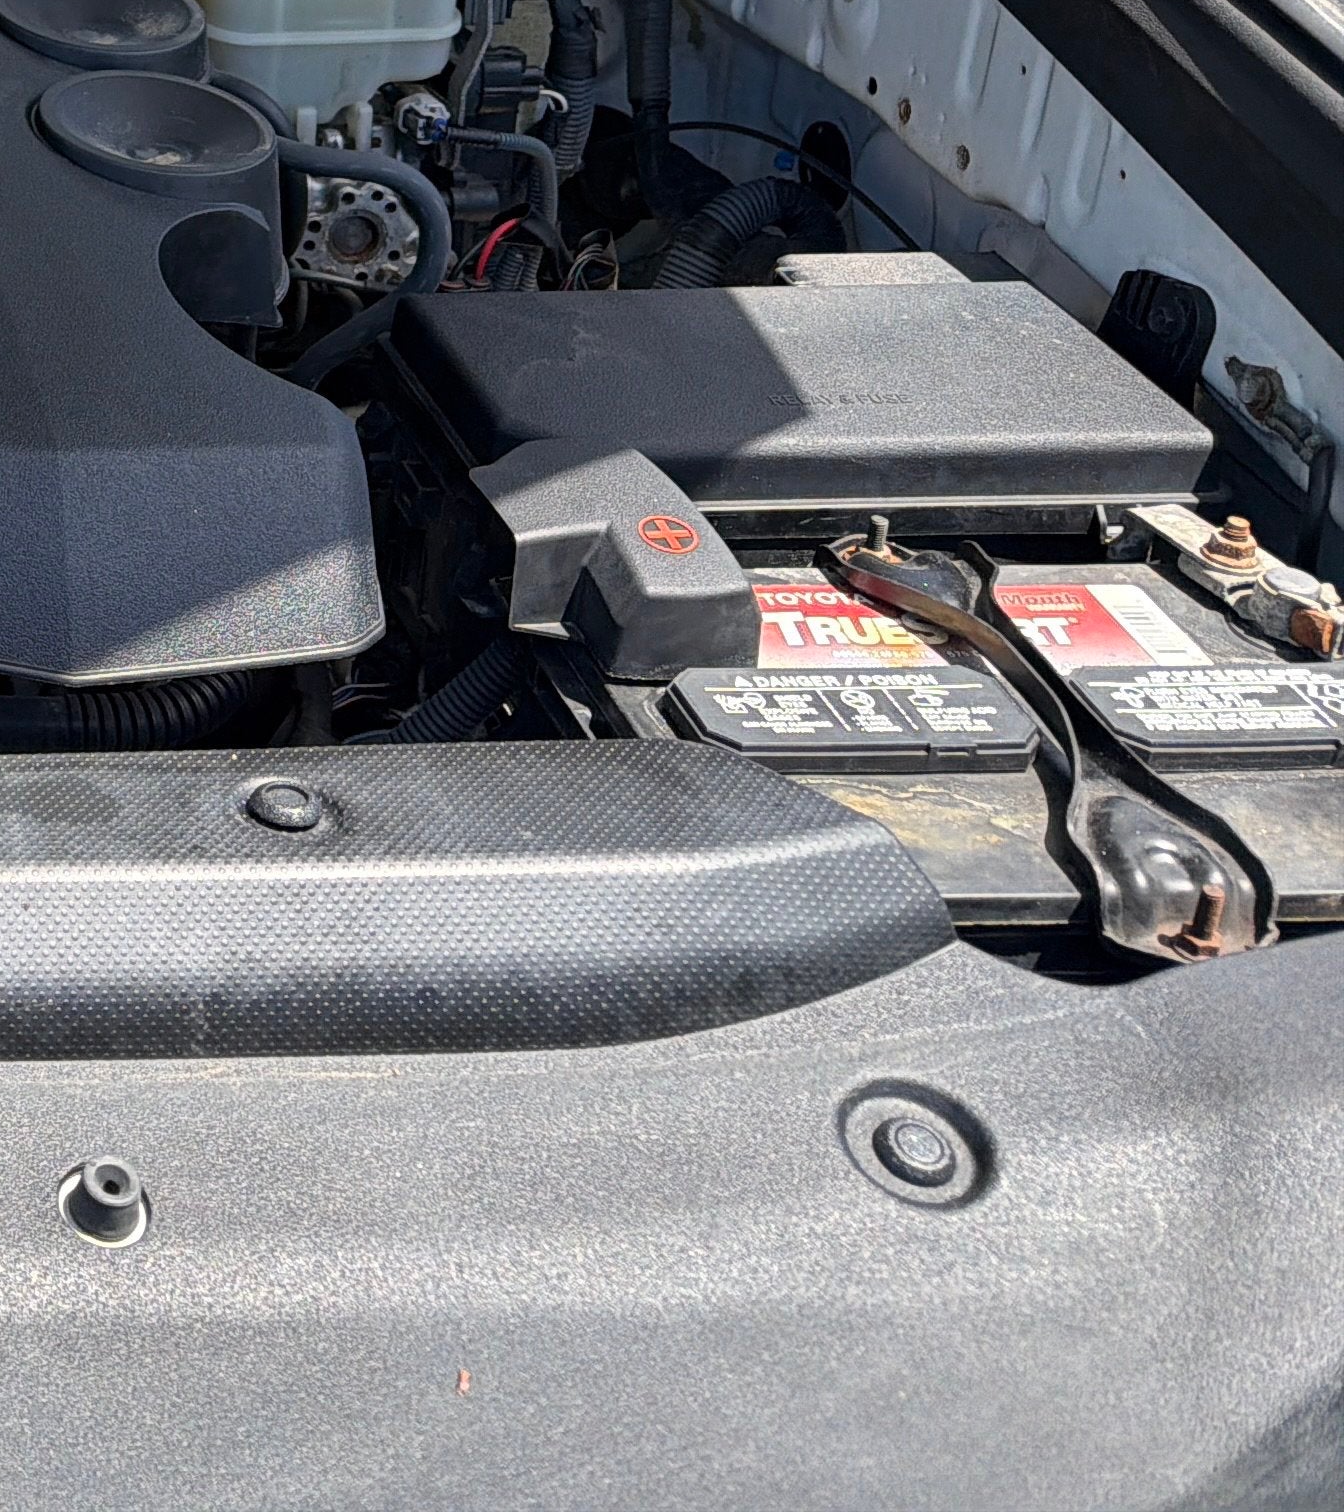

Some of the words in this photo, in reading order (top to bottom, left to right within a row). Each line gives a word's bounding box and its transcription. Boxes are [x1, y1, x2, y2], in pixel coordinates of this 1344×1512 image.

[768, 393, 834, 407] RELAY
[839, 394, 855, 405] &
[856, 393, 913, 406] FUSE
[758, 591, 874, 606] TOYOTA
[753, 675, 840, 688] DANGER
[859, 674, 938, 687] POISON
